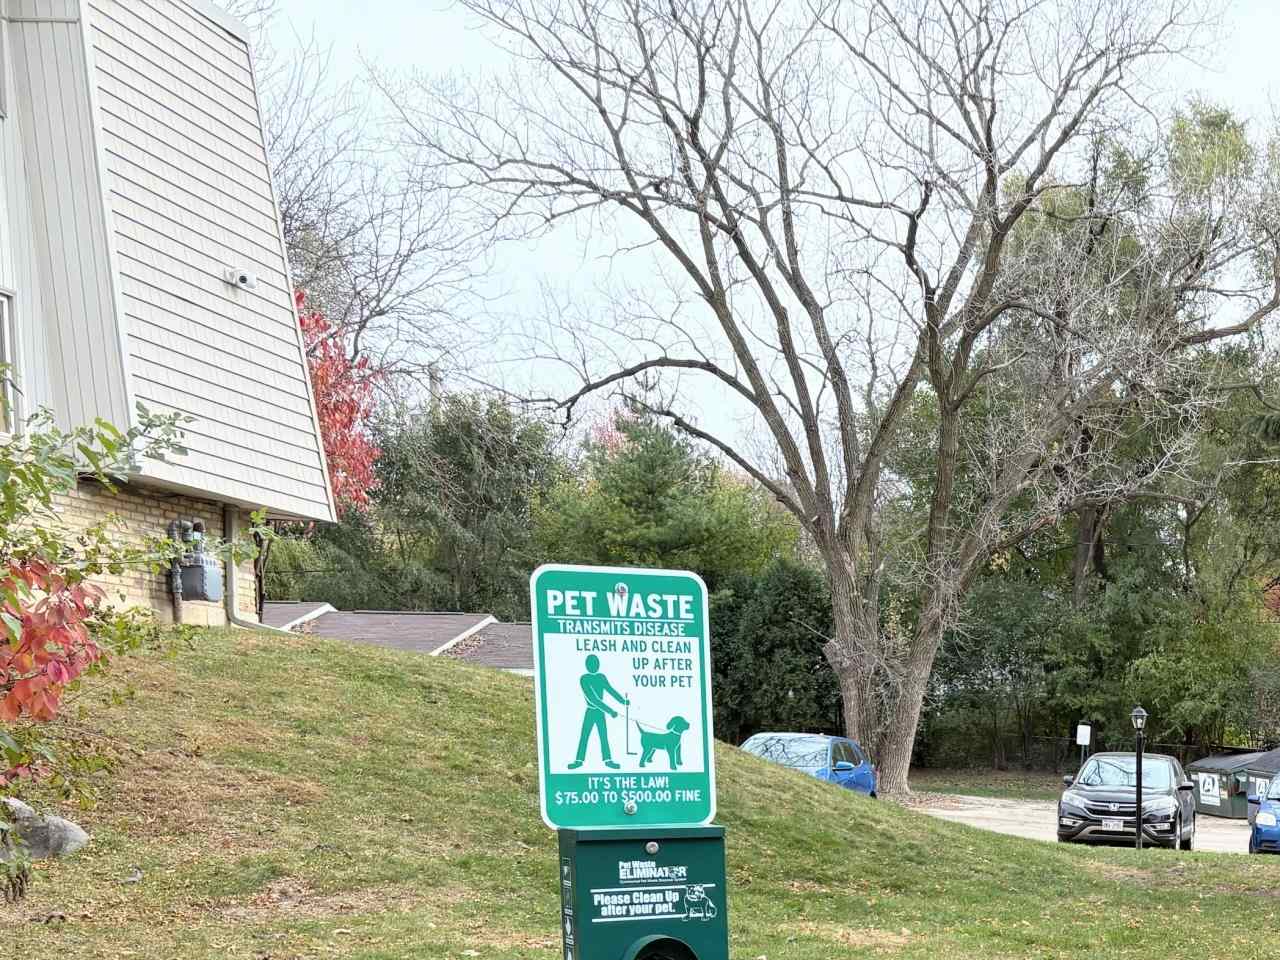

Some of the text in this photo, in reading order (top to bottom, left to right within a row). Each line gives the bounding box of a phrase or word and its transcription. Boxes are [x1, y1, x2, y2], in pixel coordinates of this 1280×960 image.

[546, 589, 694, 619] PET WASTE
[558, 619, 686, 637] TRANSMITS DISEASE
[576, 638, 692, 653] LEASH AND CLEAN
[632, 658, 692, 671] UP AFTER
[632, 675, 693, 688] YOUR PET
[588, 776, 670, 790] IT'S THE LAW!
[555, 789, 701, 805] $75.00 TO $500.00 FINE
[593, 890, 680, 906] Please Clean Up
[601, 902, 676, 916] after your pet.
